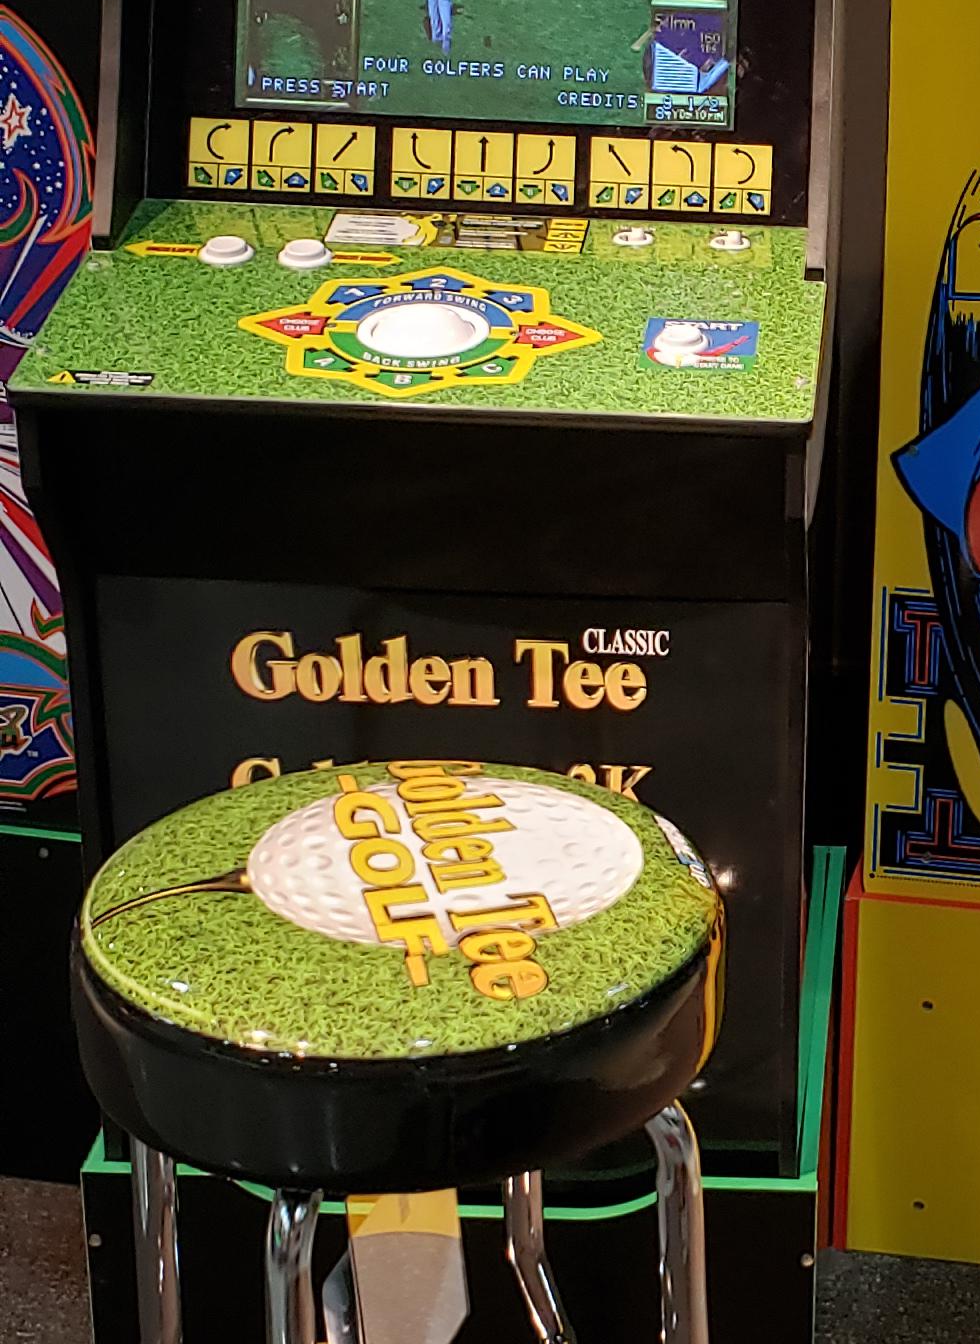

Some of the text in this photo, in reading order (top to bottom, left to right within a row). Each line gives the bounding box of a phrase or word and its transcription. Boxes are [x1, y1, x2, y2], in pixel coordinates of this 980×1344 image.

[363, 57, 610, 83] FOUR GOLFERS CAN PLAY
[262, 77, 321, 94] PRESS
[430, 277, 448, 288] 2
[373, 291, 488, 312] FORWARD SWING
[279, 318, 321, 326] CHOOSE
[525, 328, 566, 337] CHOOSE
[313, 357, 336, 367] A
[362, 351, 462, 368] BACK SWING
[481, 362, 503, 374] C
[394, 374, 413, 385] B
[583, 628, 670, 657] CLASSIC
[231, 630, 648, 712] Golden Tee
[386, 760, 550, 1001] Golden Tee
